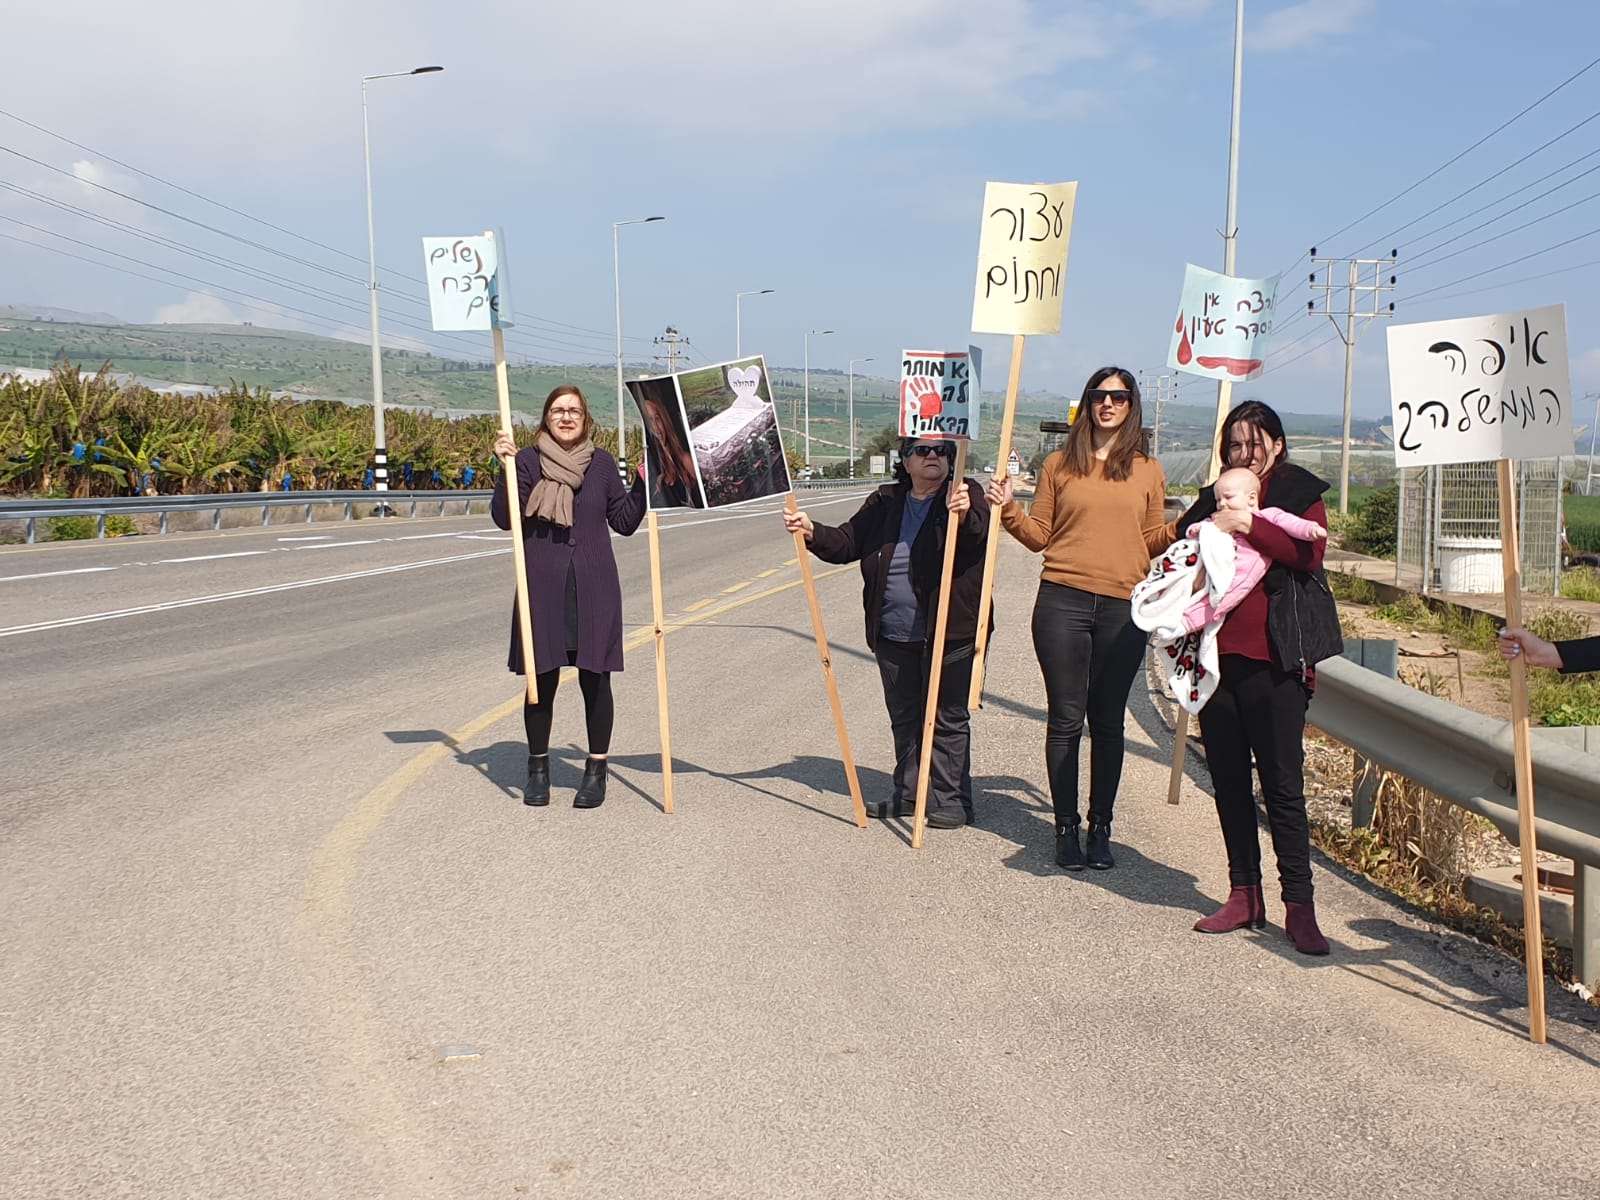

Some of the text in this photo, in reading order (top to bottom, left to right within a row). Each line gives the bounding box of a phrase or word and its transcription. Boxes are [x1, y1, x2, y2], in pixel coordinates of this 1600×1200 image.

[990, 192, 1064, 242] עצור
[1203, 292, 1220, 317] אין
[1428, 317, 1549, 376] איפה
[732, 378, 756, 388] תהילה
